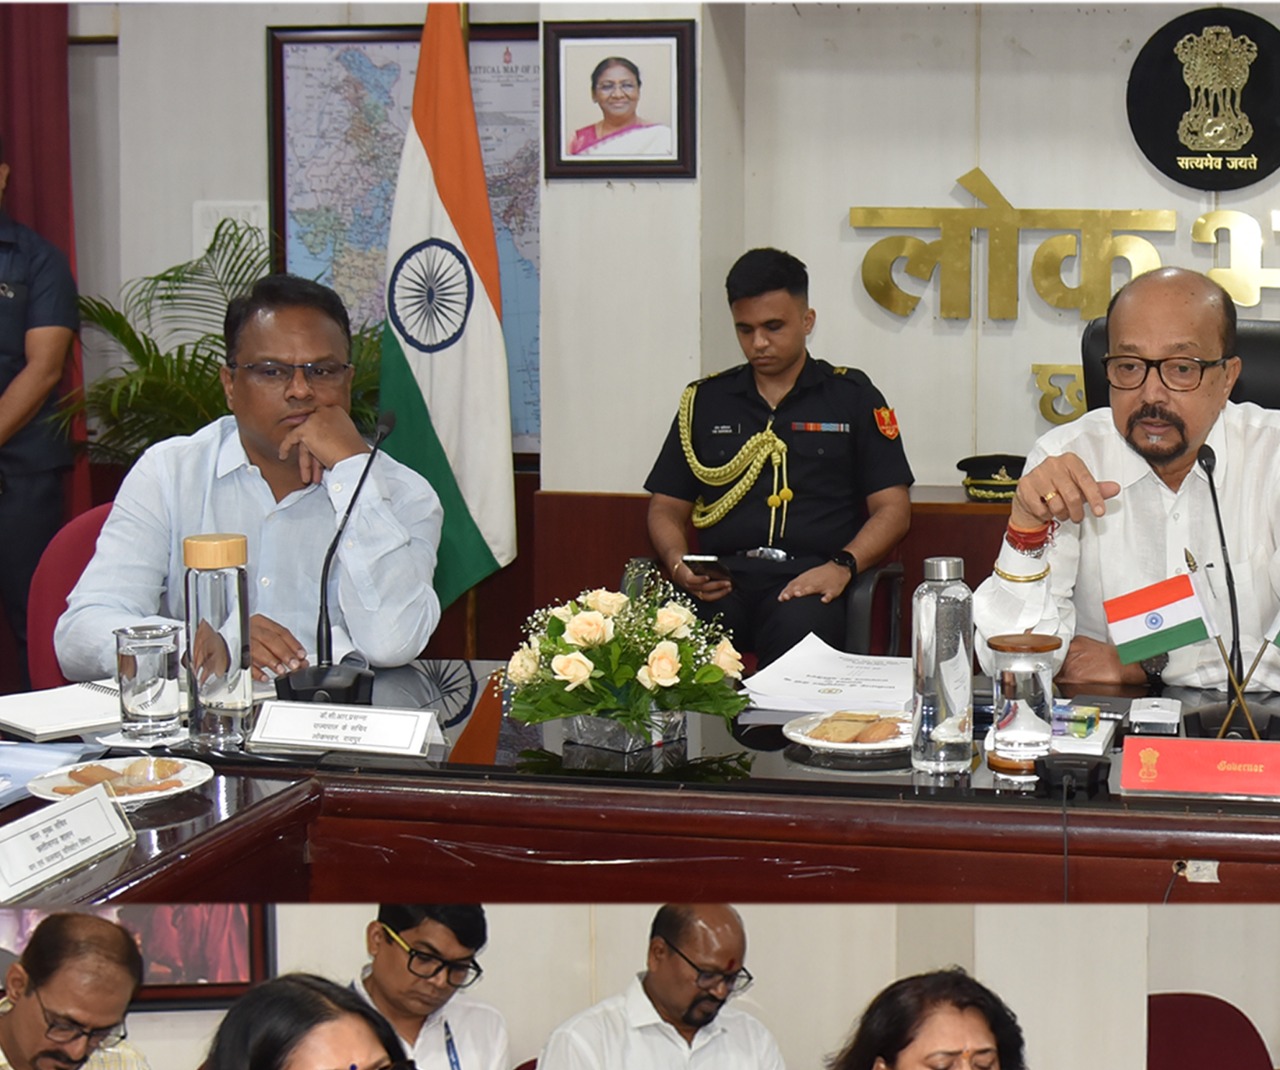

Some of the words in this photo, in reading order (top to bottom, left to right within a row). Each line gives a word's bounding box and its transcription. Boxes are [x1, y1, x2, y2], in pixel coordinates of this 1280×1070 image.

[470, 65, 501, 75] LITICAL
[1176, 153, 1223, 170] सत्यमेव
[1225, 154, 1259, 170] जयते
[850, 167, 1177, 321] लोक
[1216, 759, 1265, 773] Governor
